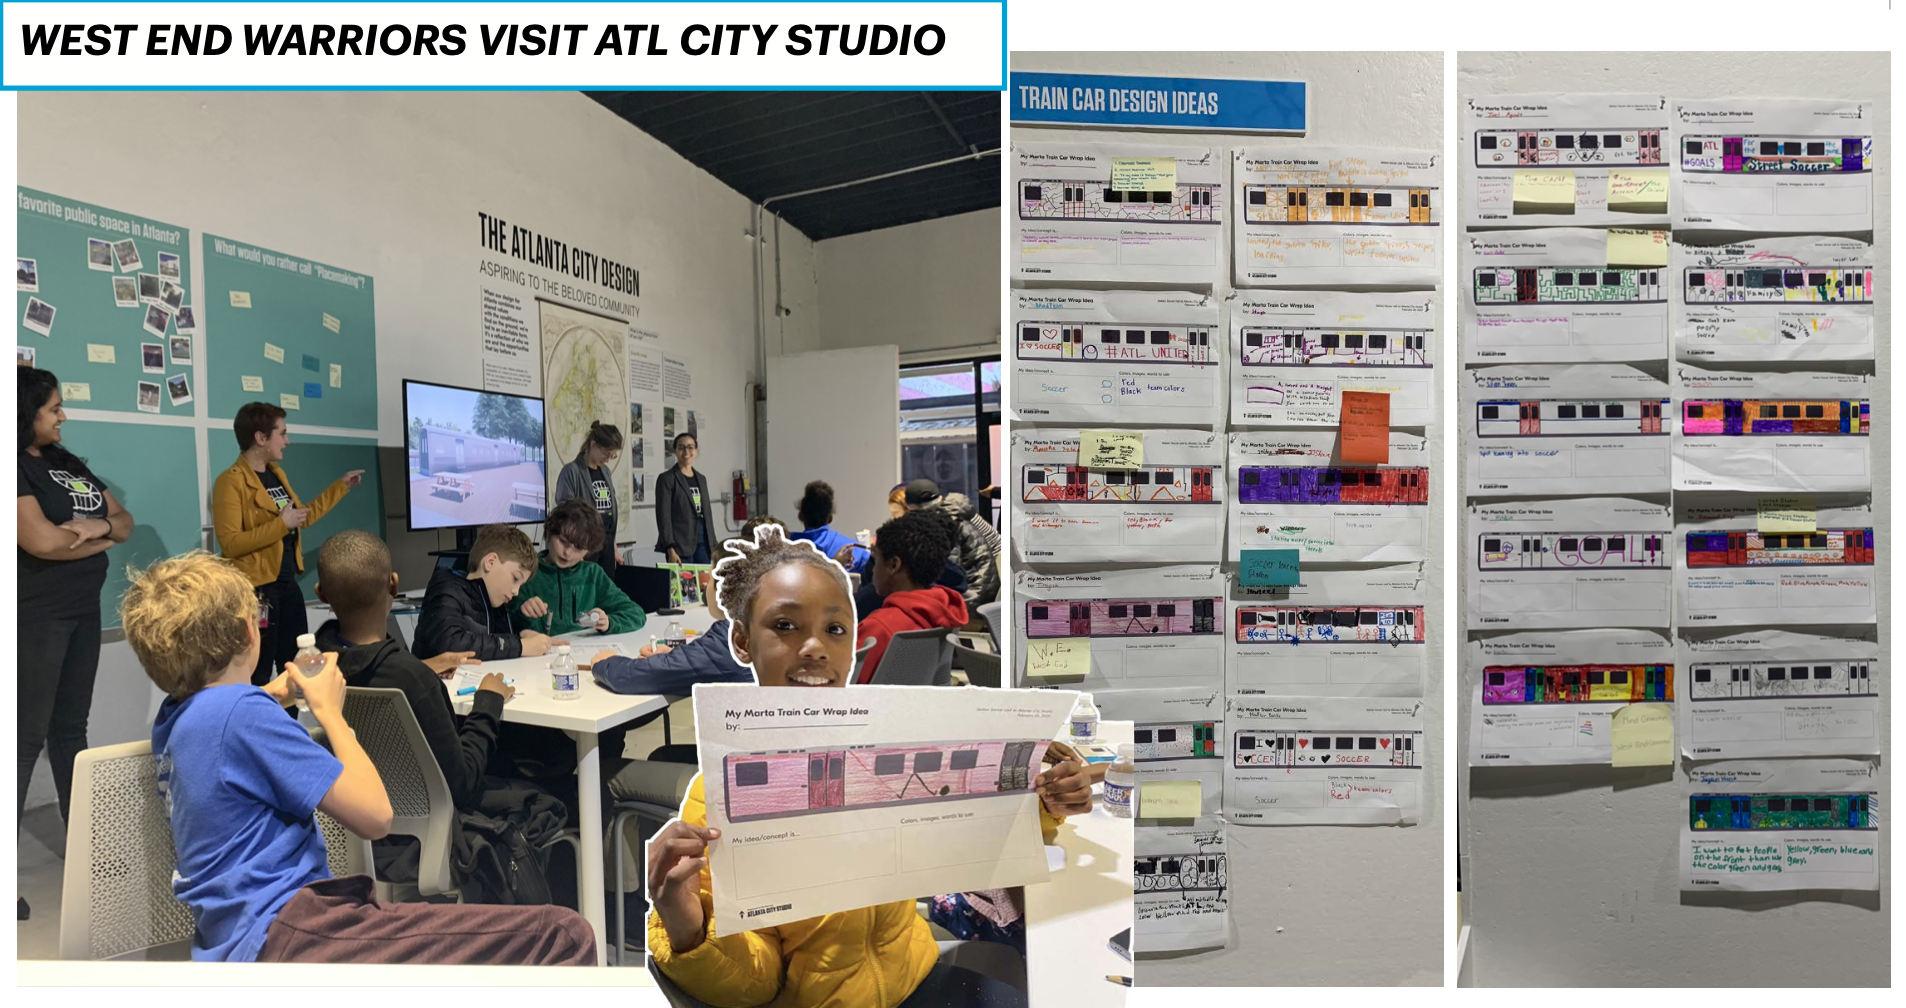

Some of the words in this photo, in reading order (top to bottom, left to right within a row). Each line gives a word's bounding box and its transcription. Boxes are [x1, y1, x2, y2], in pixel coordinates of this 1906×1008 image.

[1019, 85, 1067, 110] TRAIN
[1072, 87, 1105, 111] CAR
[1109, 88, 1167, 113] DESIGN
[1172, 91, 1219, 115] IDEAS
[1703, 142, 1719, 151] ATL
[1826, 141, 1836, 149] the
[1684, 158, 1715, 167] #GOALS
[1749, 158, 1783, 171] Street
[1790, 158, 1831, 172] Soccer
[18, 192, 62, 217] favorite
[65, 206, 97, 226] public
[99, 215, 130, 233] space
[131, 220, 141, 236] in
[143, 223, 181, 245] Atlanta?
[214, 239, 236, 256] What
[237, 247, 261, 263] would
[262, 253, 276, 266] you
[276, 257, 298, 271] rather
[299, 262, 312, 275] call
[478, 211, 507, 255] THE
[511, 224, 569, 275] ATLANTA
[572, 247, 598, 284] CITY
[602, 257, 640, 298] DESIGN
[479, 260, 525, 286] ASPIRING
[528, 274, 540, 290] TO
[542, 279, 559, 296] THE
[561, 284, 597, 306] BELOVED
[598, 296, 641, 318] COMMUNITY
[483, 288, 495, 297] When
[502, 294, 514, 303] design
[483, 303, 497, 311] shared
[498, 300, 515, 309] combines
[484, 316, 492, 324] find
[499, 315, 518, 323] conditions
[501, 327, 518, 336] inevitable
[493, 333, 511, 342] reflection
[506, 343, 529, 353] opportunities
[1034, 343, 1062, 351] SOCCER
[1152, 347, 1189, 359] UNITED
[1041, 383, 1068, 393] Soccer
[1120, 387, 1142, 396] Black
[1164, 384, 1185, 392] colors
[1554, 534, 1656, 567] GOAL!
[725, 709, 741, 719] My
[743, 708, 775, 718] Marta
[777, 708, 801, 717] Train
[803, 707, 820, 716] Car
[822, 708, 847, 717] Wrap
[849, 707, 869, 716] Idea
[725, 722, 741, 732] by:
[1256, 739, 1263, 748] I
[1335, 754, 1370, 763] SOCCER
[1330, 789, 1350, 800] Red
[1255, 796, 1279, 804] Soccer
[900, 817, 919, 825] Colors,
[920, 815, 940, 824] images,
[744, 833, 788, 843] idea/concept
[1692, 845, 1702, 854] I
[1722, 855, 1746, 864] front
[1728, 863, 1750, 872] green
[747, 907, 764, 918] ATLANTA
[765, 905, 776, 915] CITY
[776, 903, 792, 913] STUDIO
